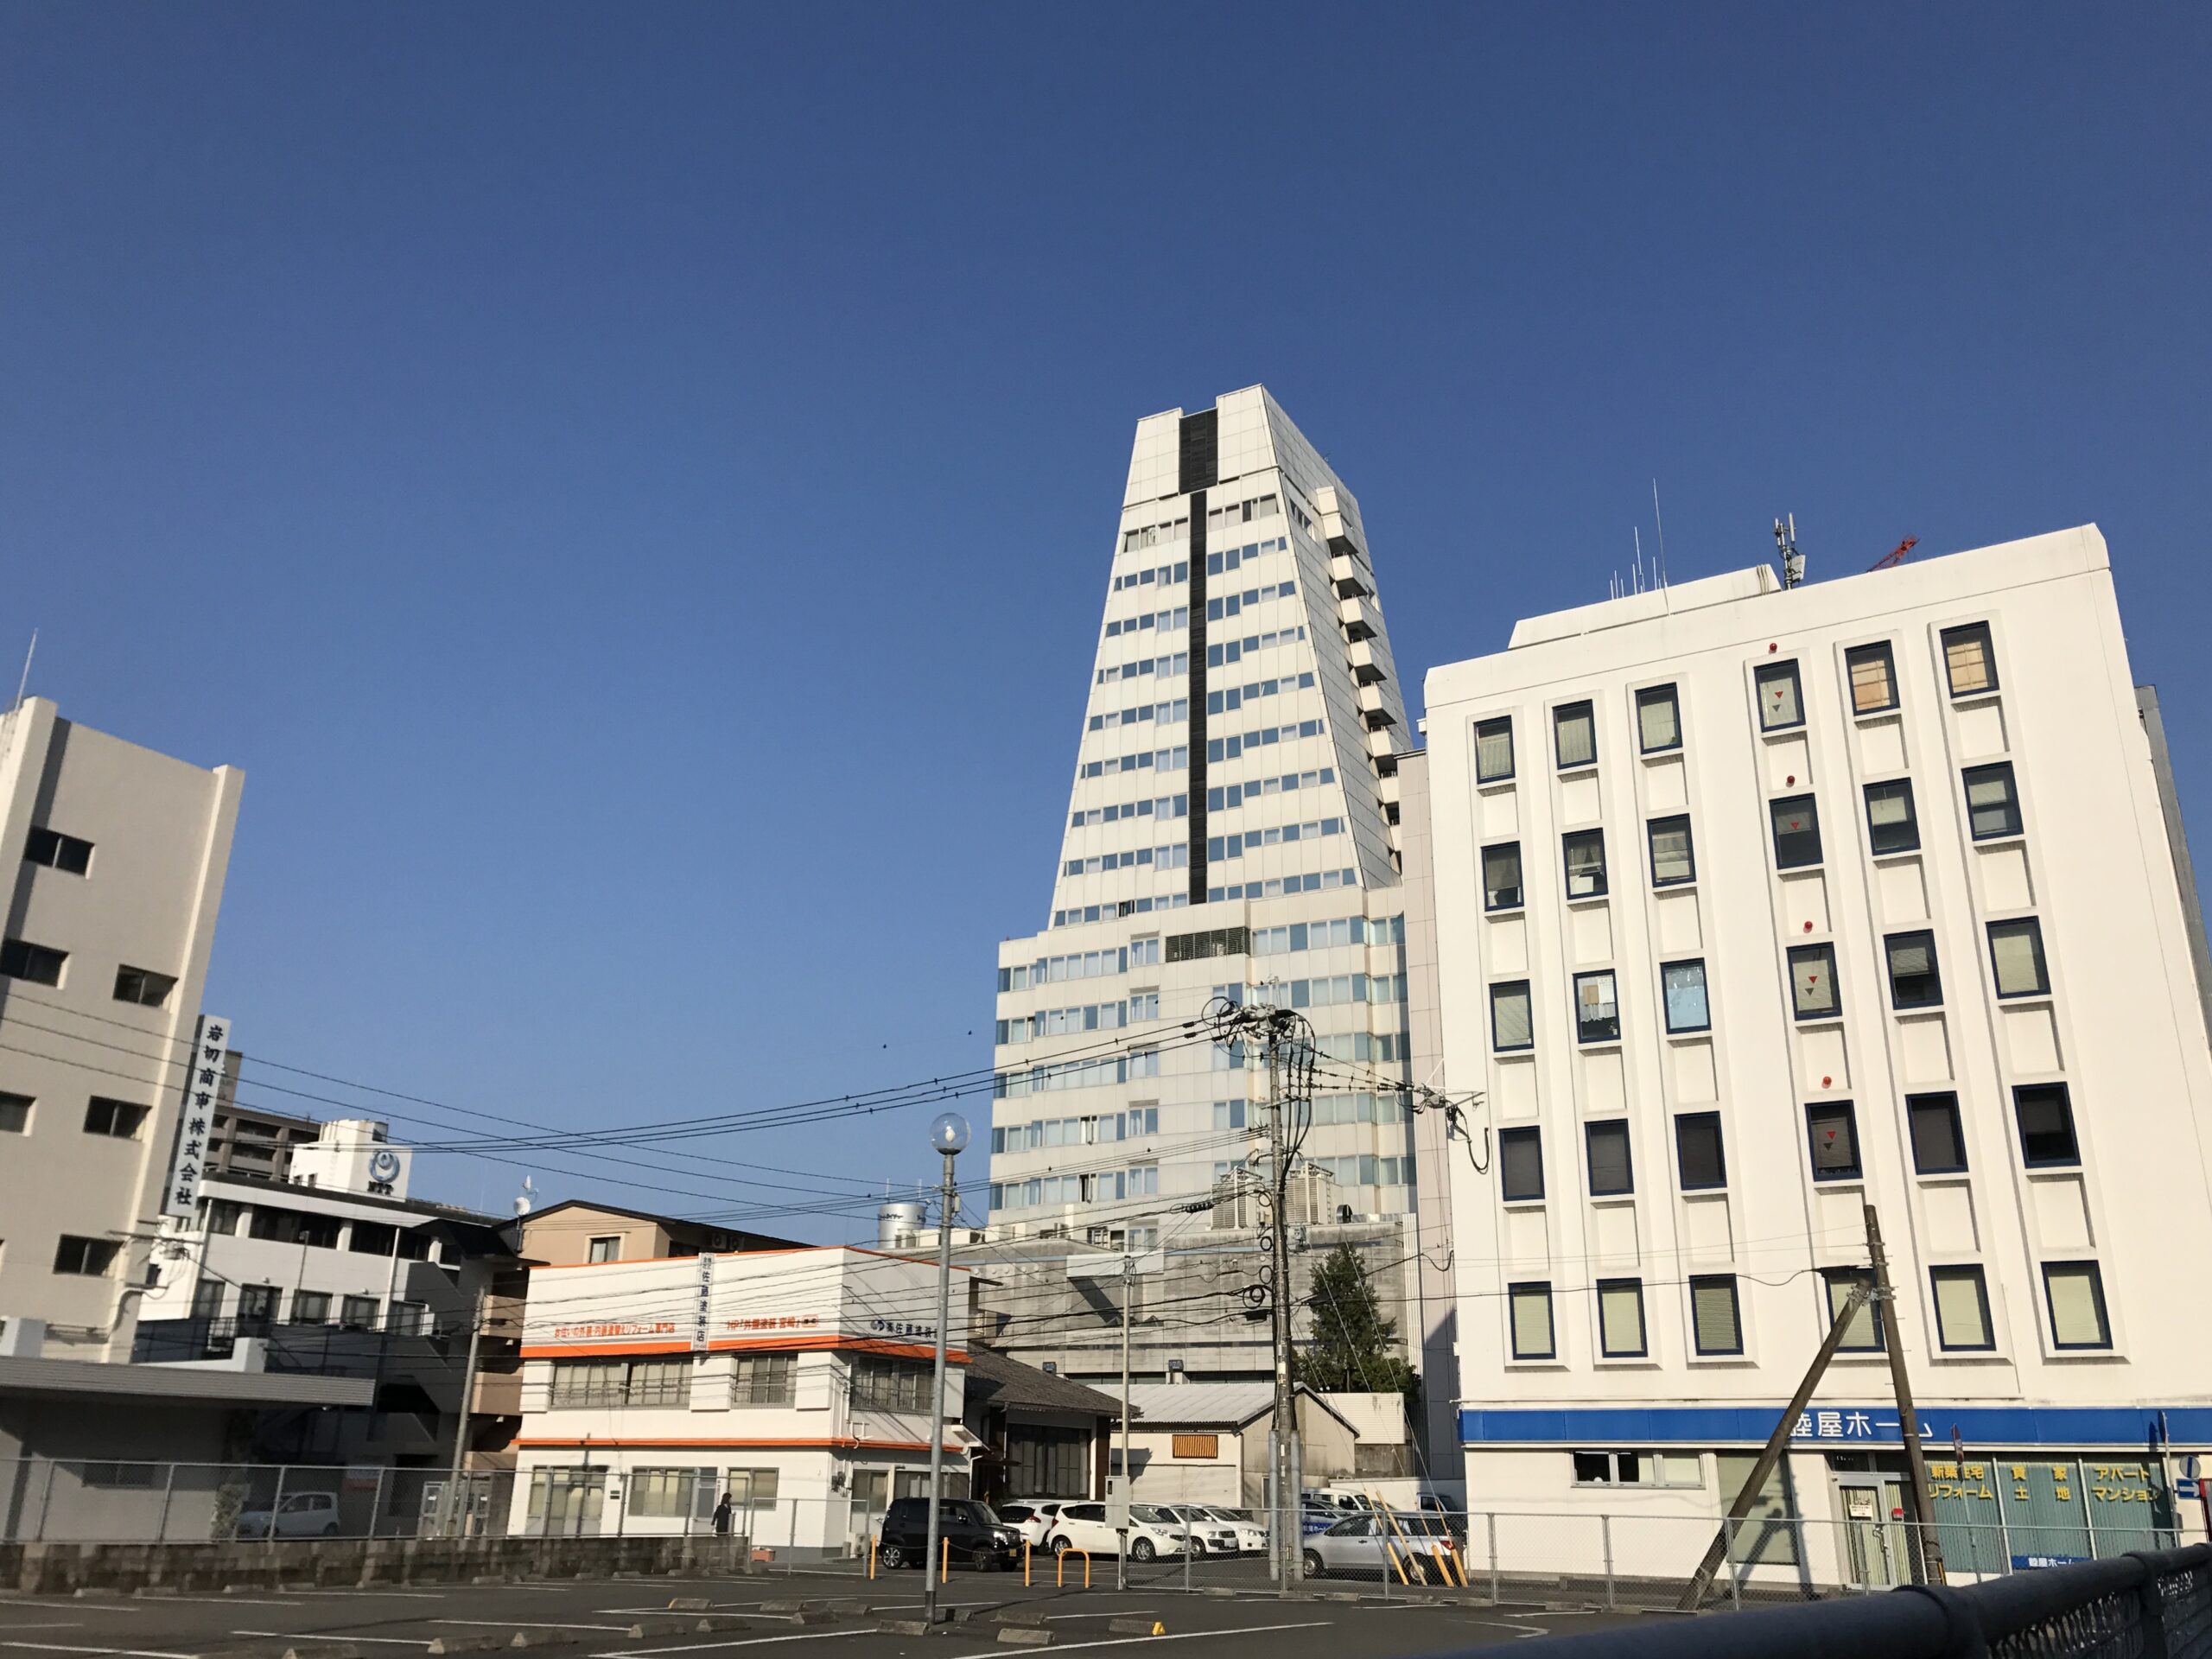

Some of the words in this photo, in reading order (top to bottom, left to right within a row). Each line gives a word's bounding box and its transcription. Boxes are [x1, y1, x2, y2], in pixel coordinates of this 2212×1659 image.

[176, 1025, 223, 1205] 岩切商事株式会社
[367, 1181, 393, 1196] NTT
[2095, 1466, 2150, 1480] アパート
[1929, 1484, 1993, 1499] リフォーム
